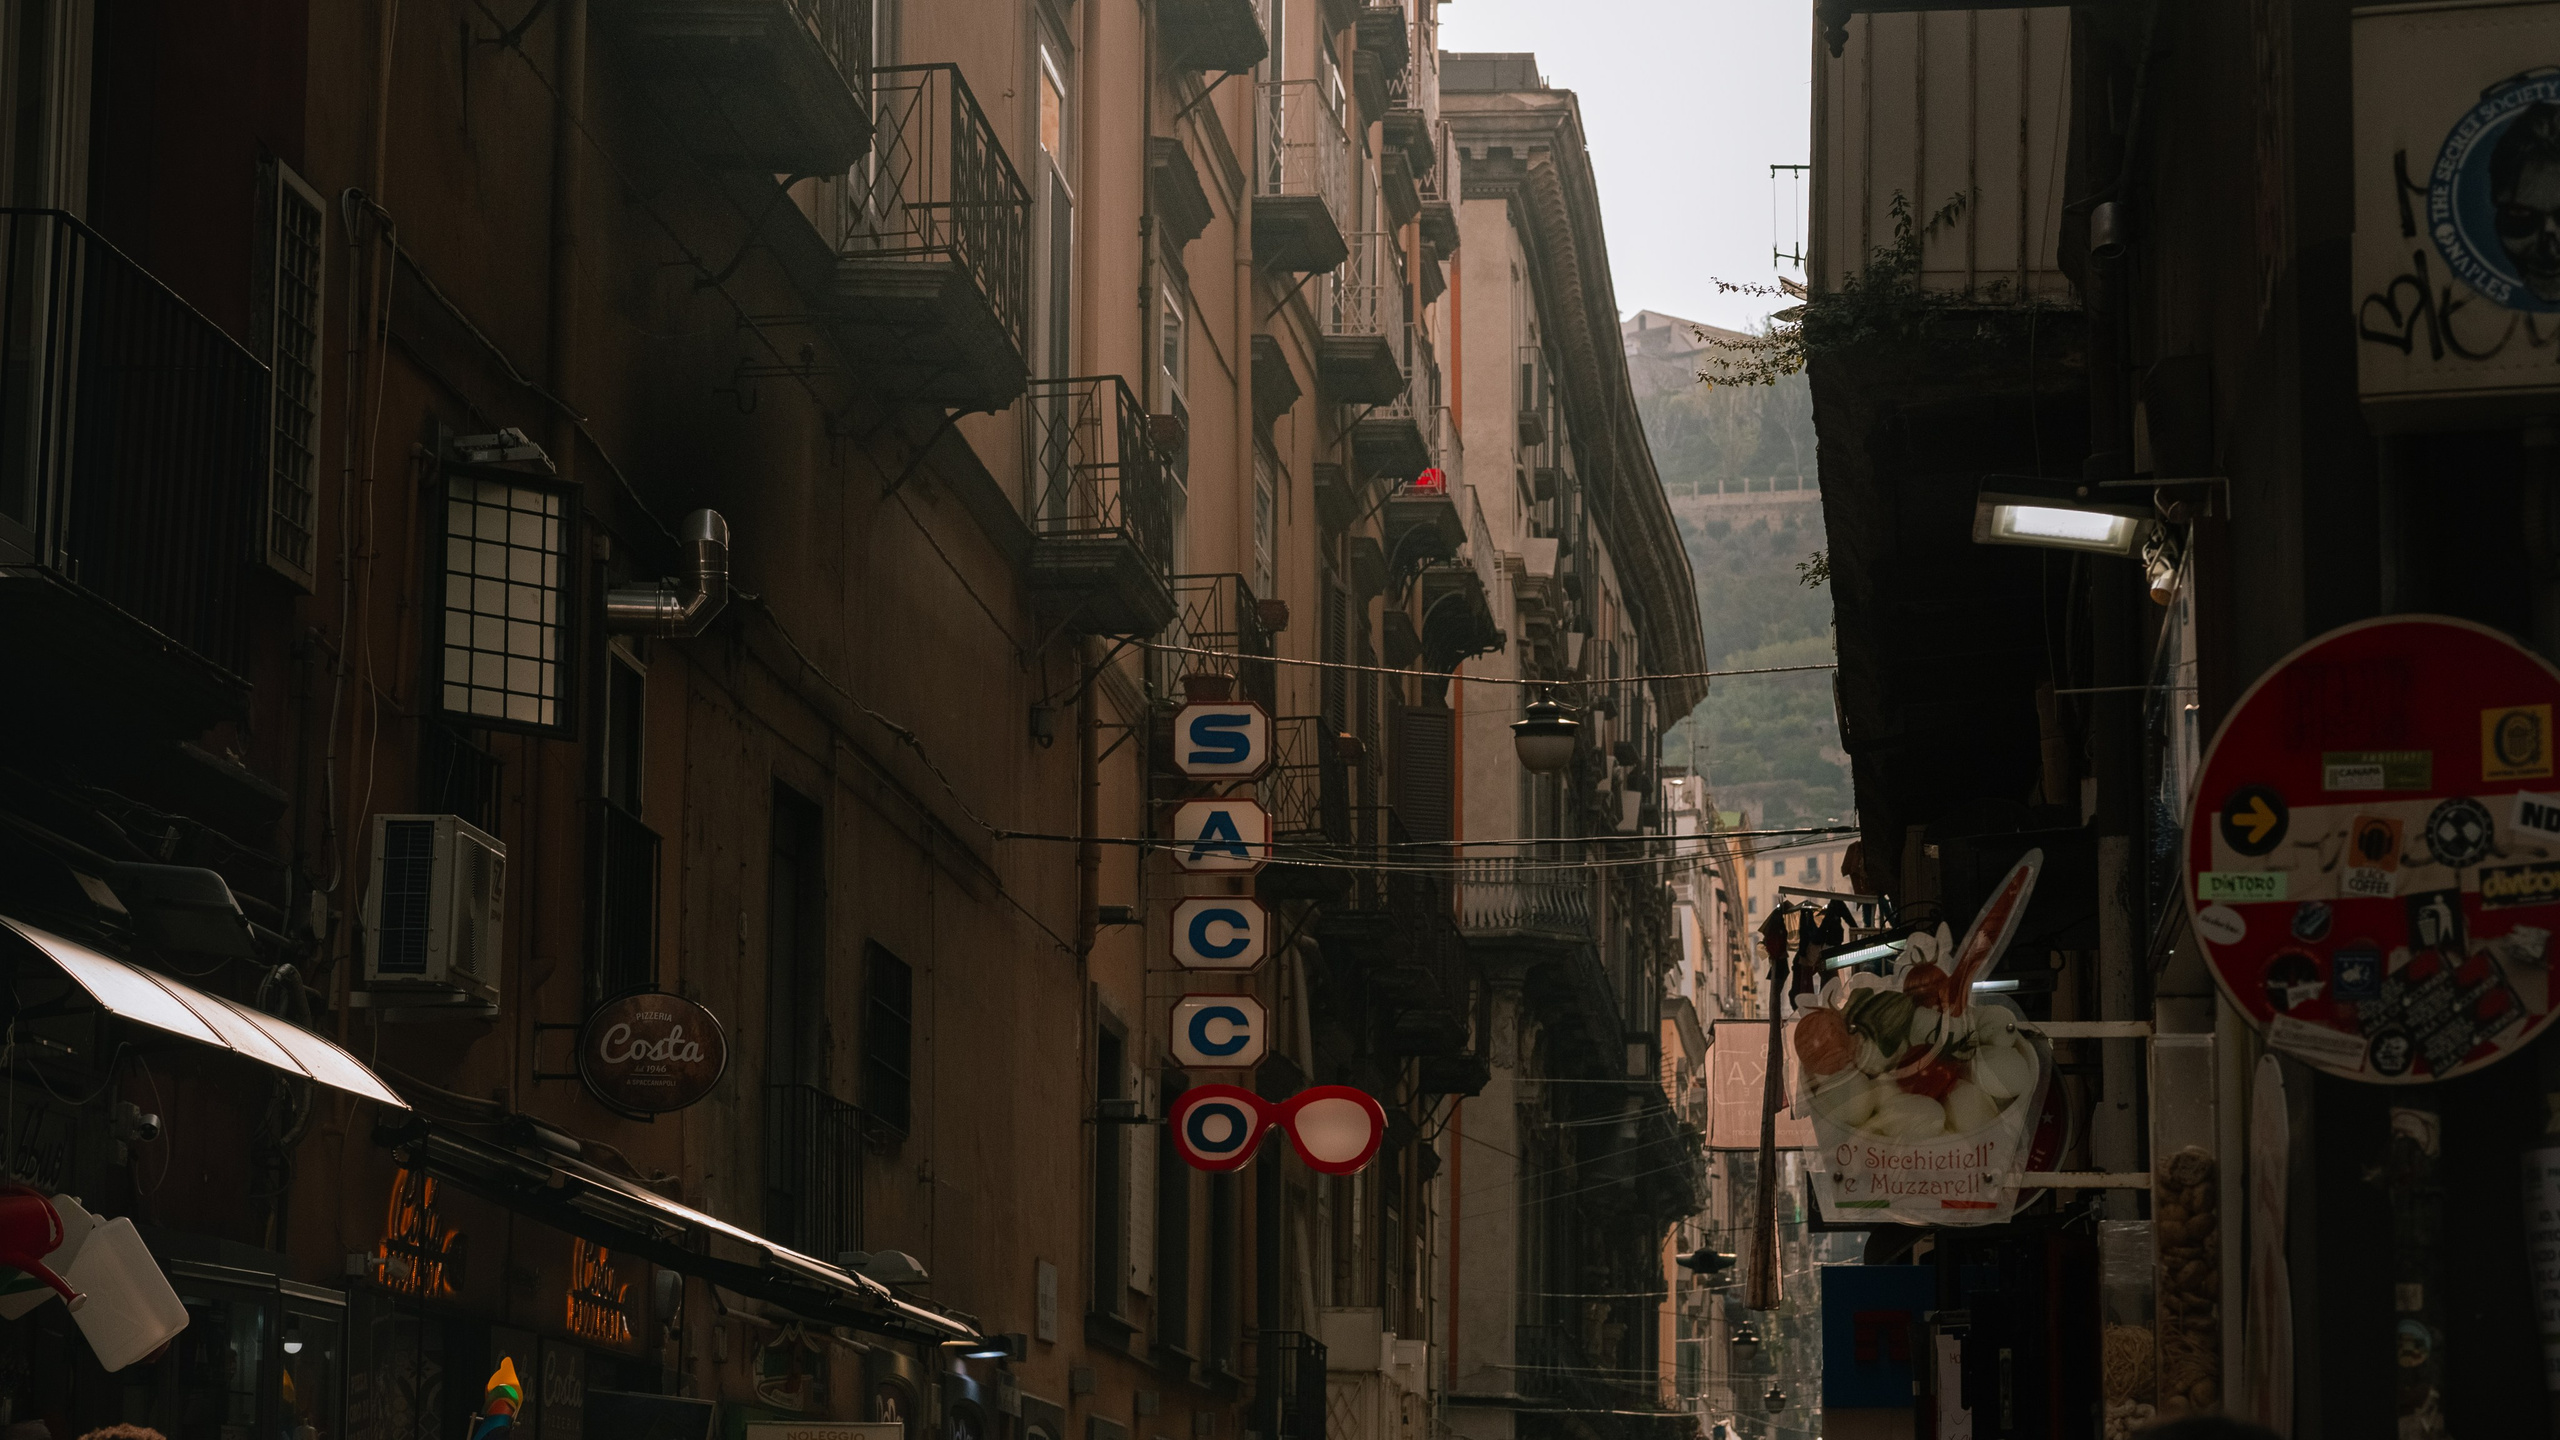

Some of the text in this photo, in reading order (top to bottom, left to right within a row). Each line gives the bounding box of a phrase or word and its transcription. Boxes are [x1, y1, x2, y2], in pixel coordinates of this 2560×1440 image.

[2431, 79, 2560, 222] THE SECRET SOCIETY
[2449, 246, 2512, 301] NAPLES
[2348, 877, 2390, 894] COFFEE
[1187, 712, 1251, 1154] SACCO
[635, 1011, 673, 1023] PIZZERIA
[600, 1022, 705, 1064] Costa
[646, 1064, 667, 1073] 1946
[626, 1078, 677, 1087] A SPACCANAPOLI
[786, 1430, 866, 1440] NOLEGGIO
